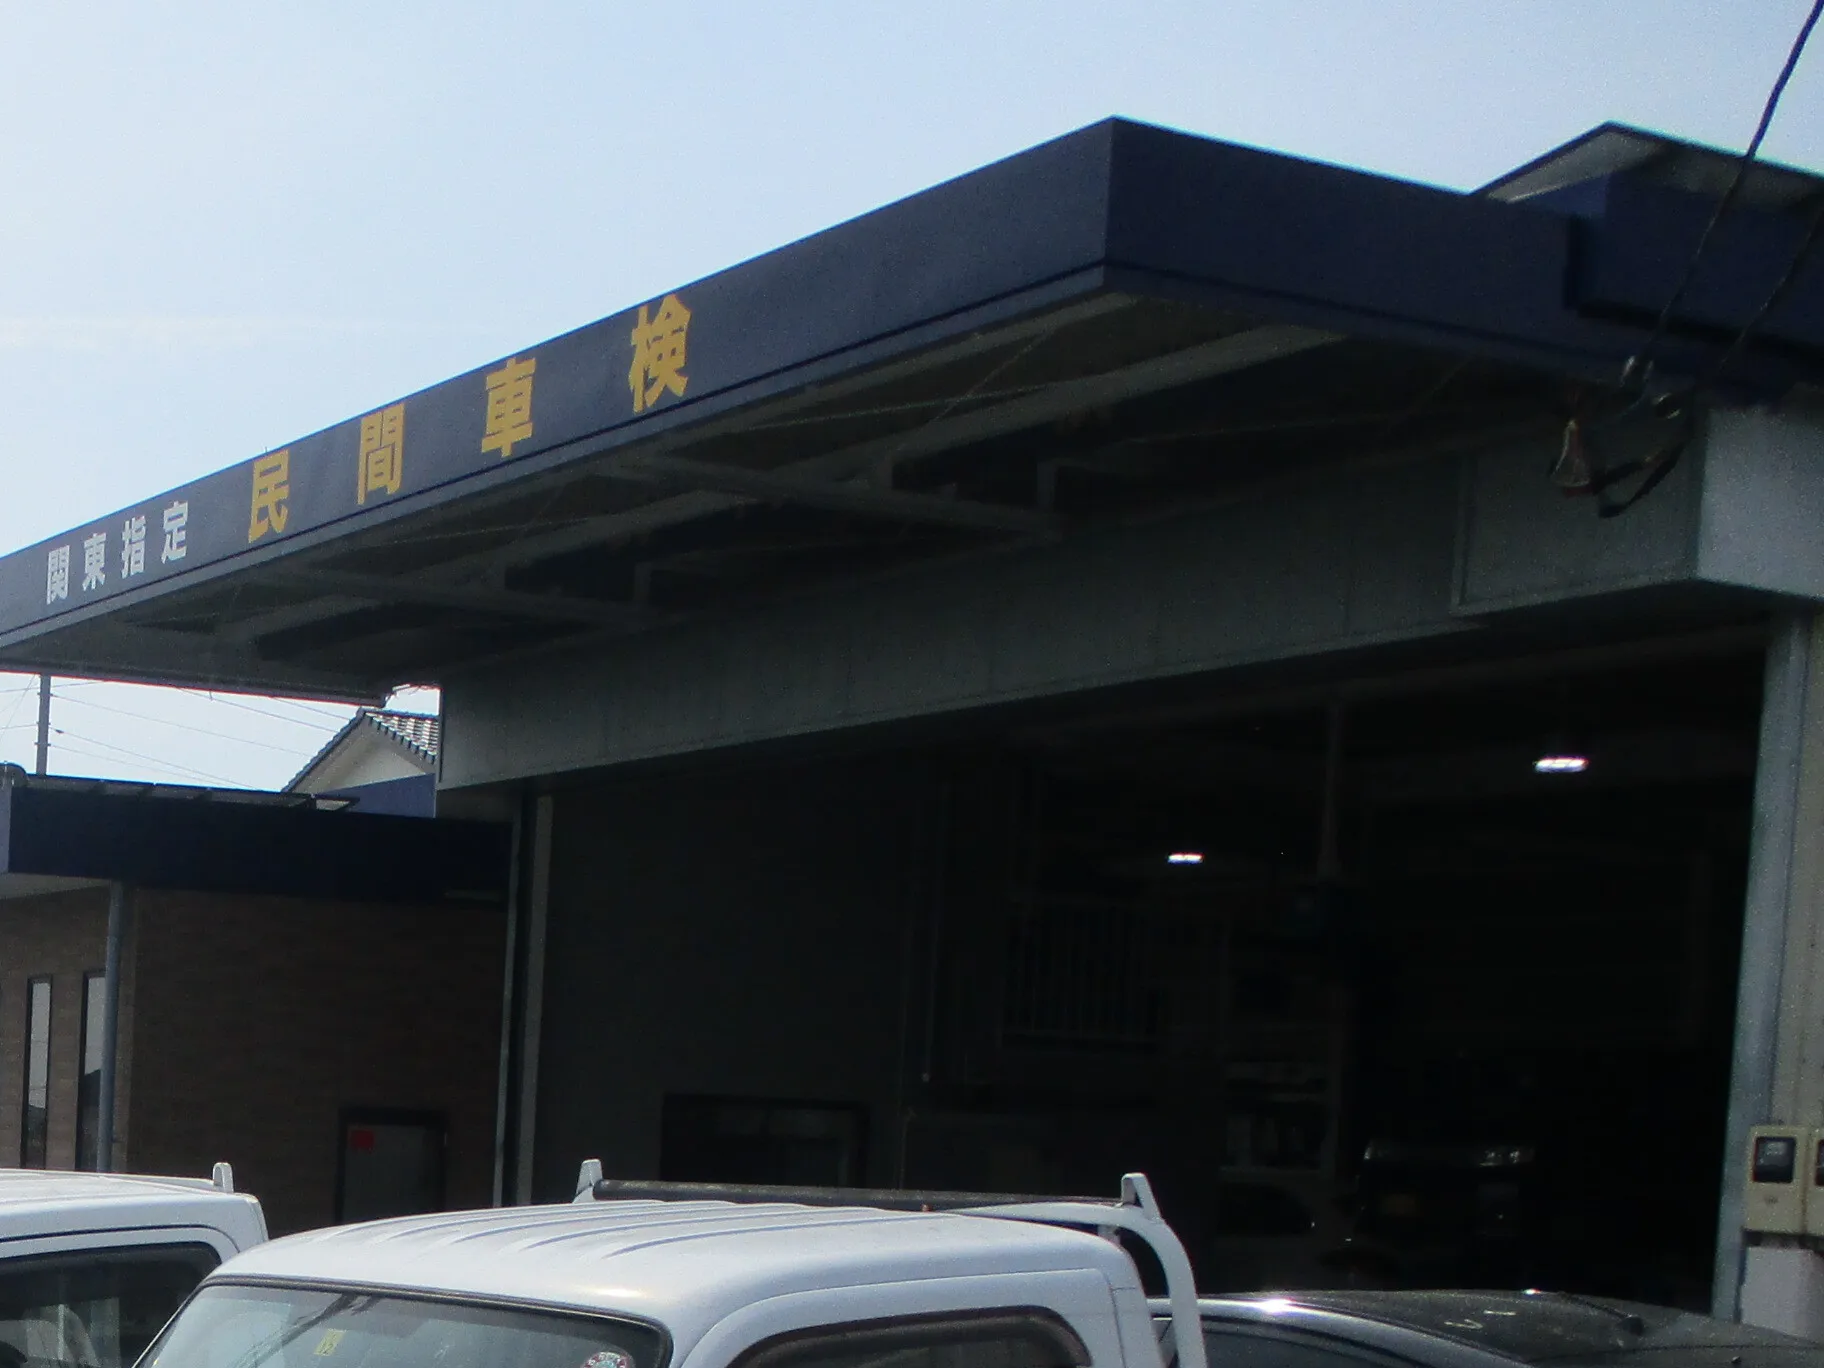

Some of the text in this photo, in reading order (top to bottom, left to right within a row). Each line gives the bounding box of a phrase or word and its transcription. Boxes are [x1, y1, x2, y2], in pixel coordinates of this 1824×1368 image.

[45, 293, 693, 606] 関東指定 民間車検
